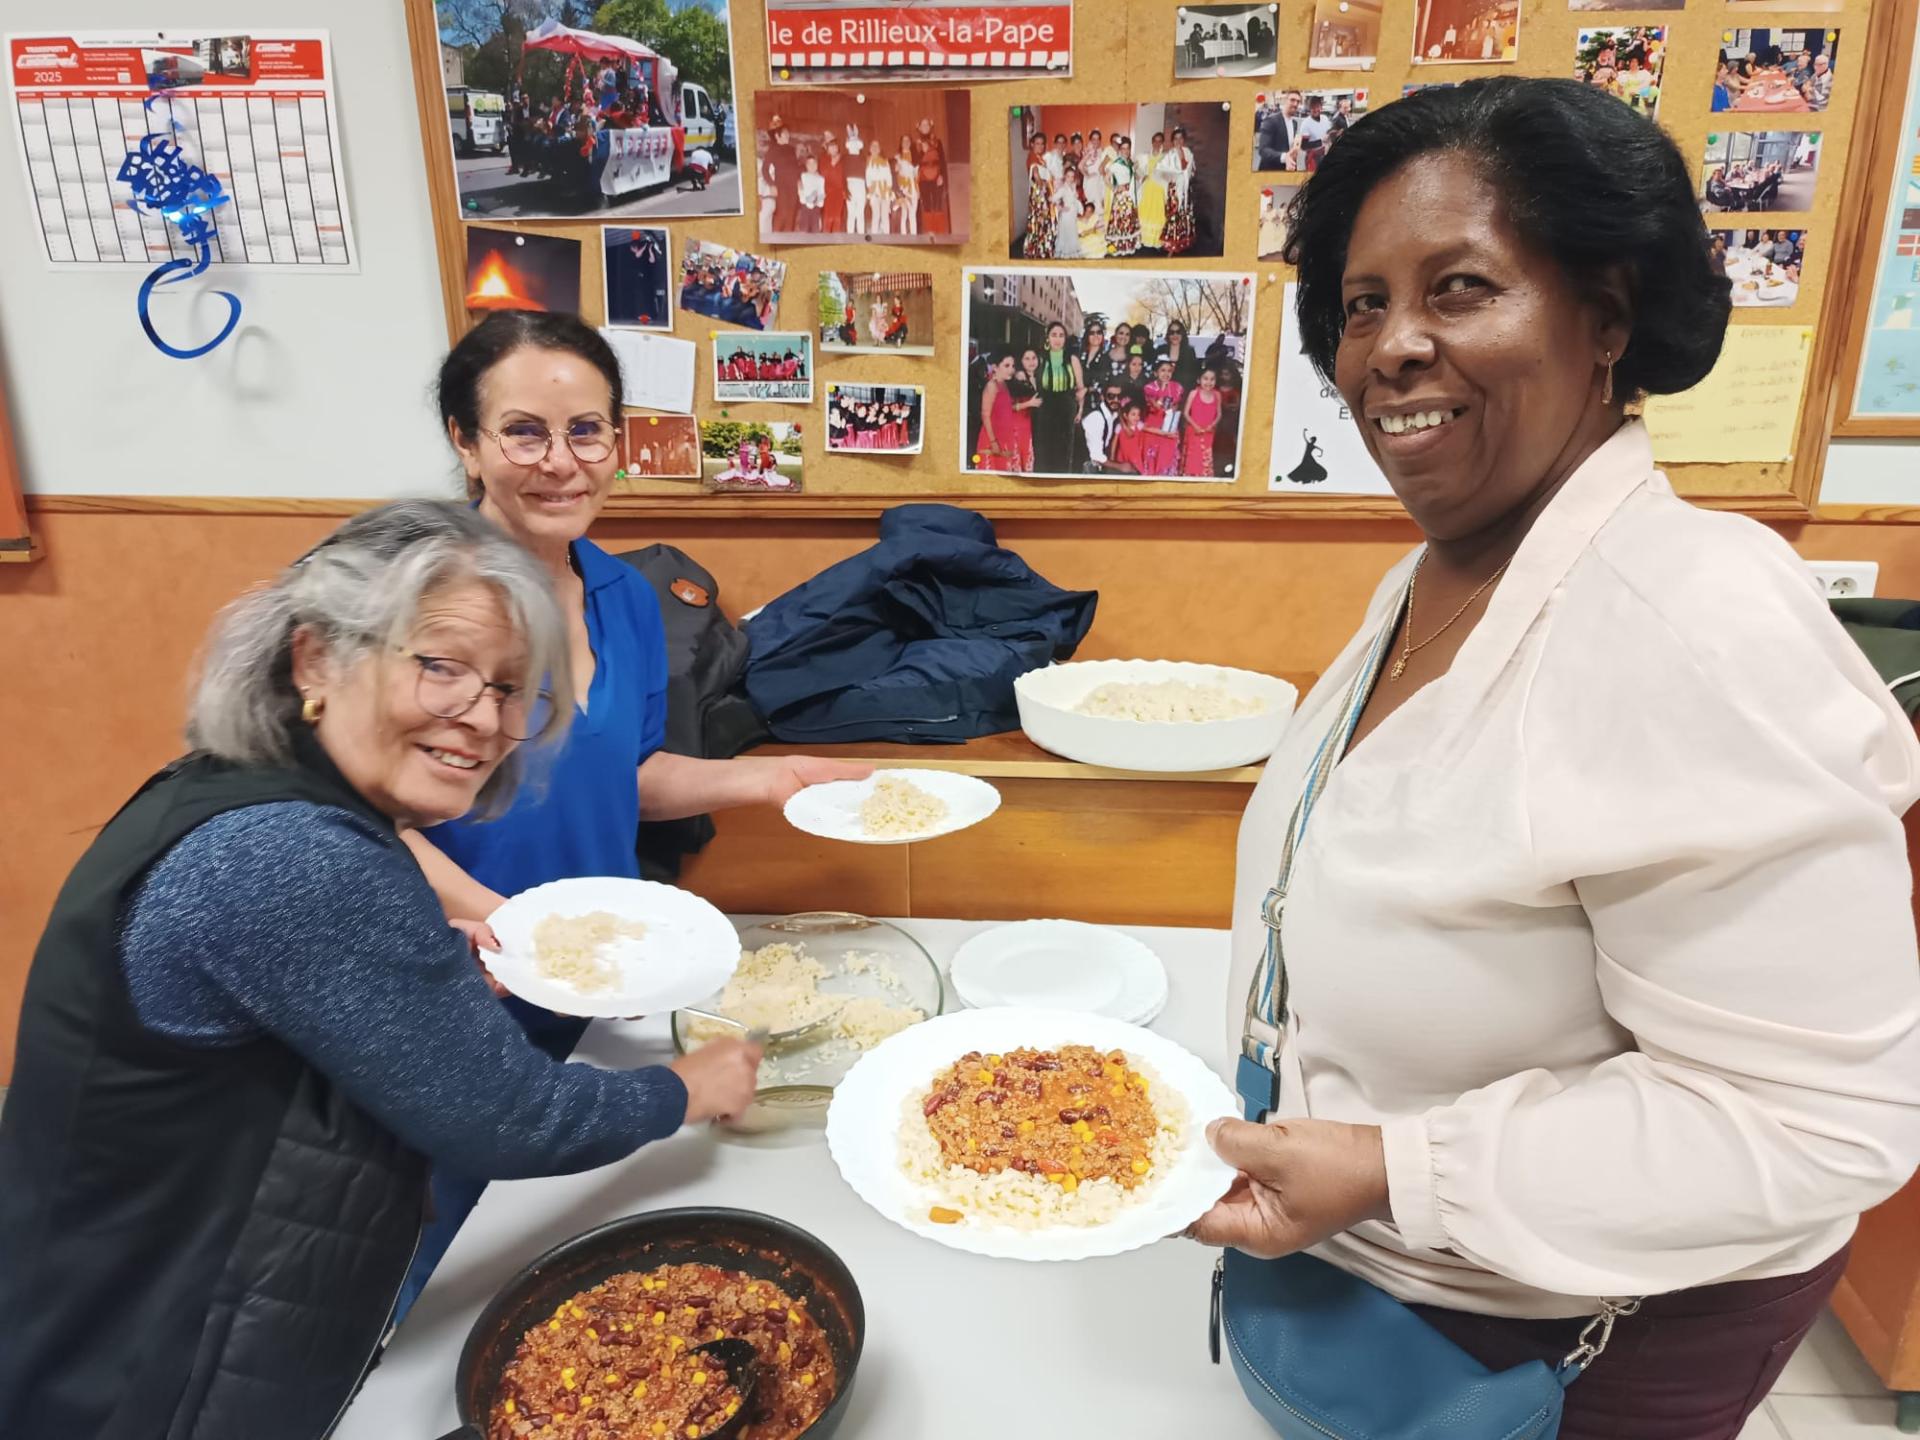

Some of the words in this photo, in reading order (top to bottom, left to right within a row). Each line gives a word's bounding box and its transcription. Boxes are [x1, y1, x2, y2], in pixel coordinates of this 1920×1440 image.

[771, 20, 793, 45] le
[801, 20, 833, 45] de
[840, 17, 1055, 49] Rillieux-la-Pape
[33, 71, 63, 83] 2025
